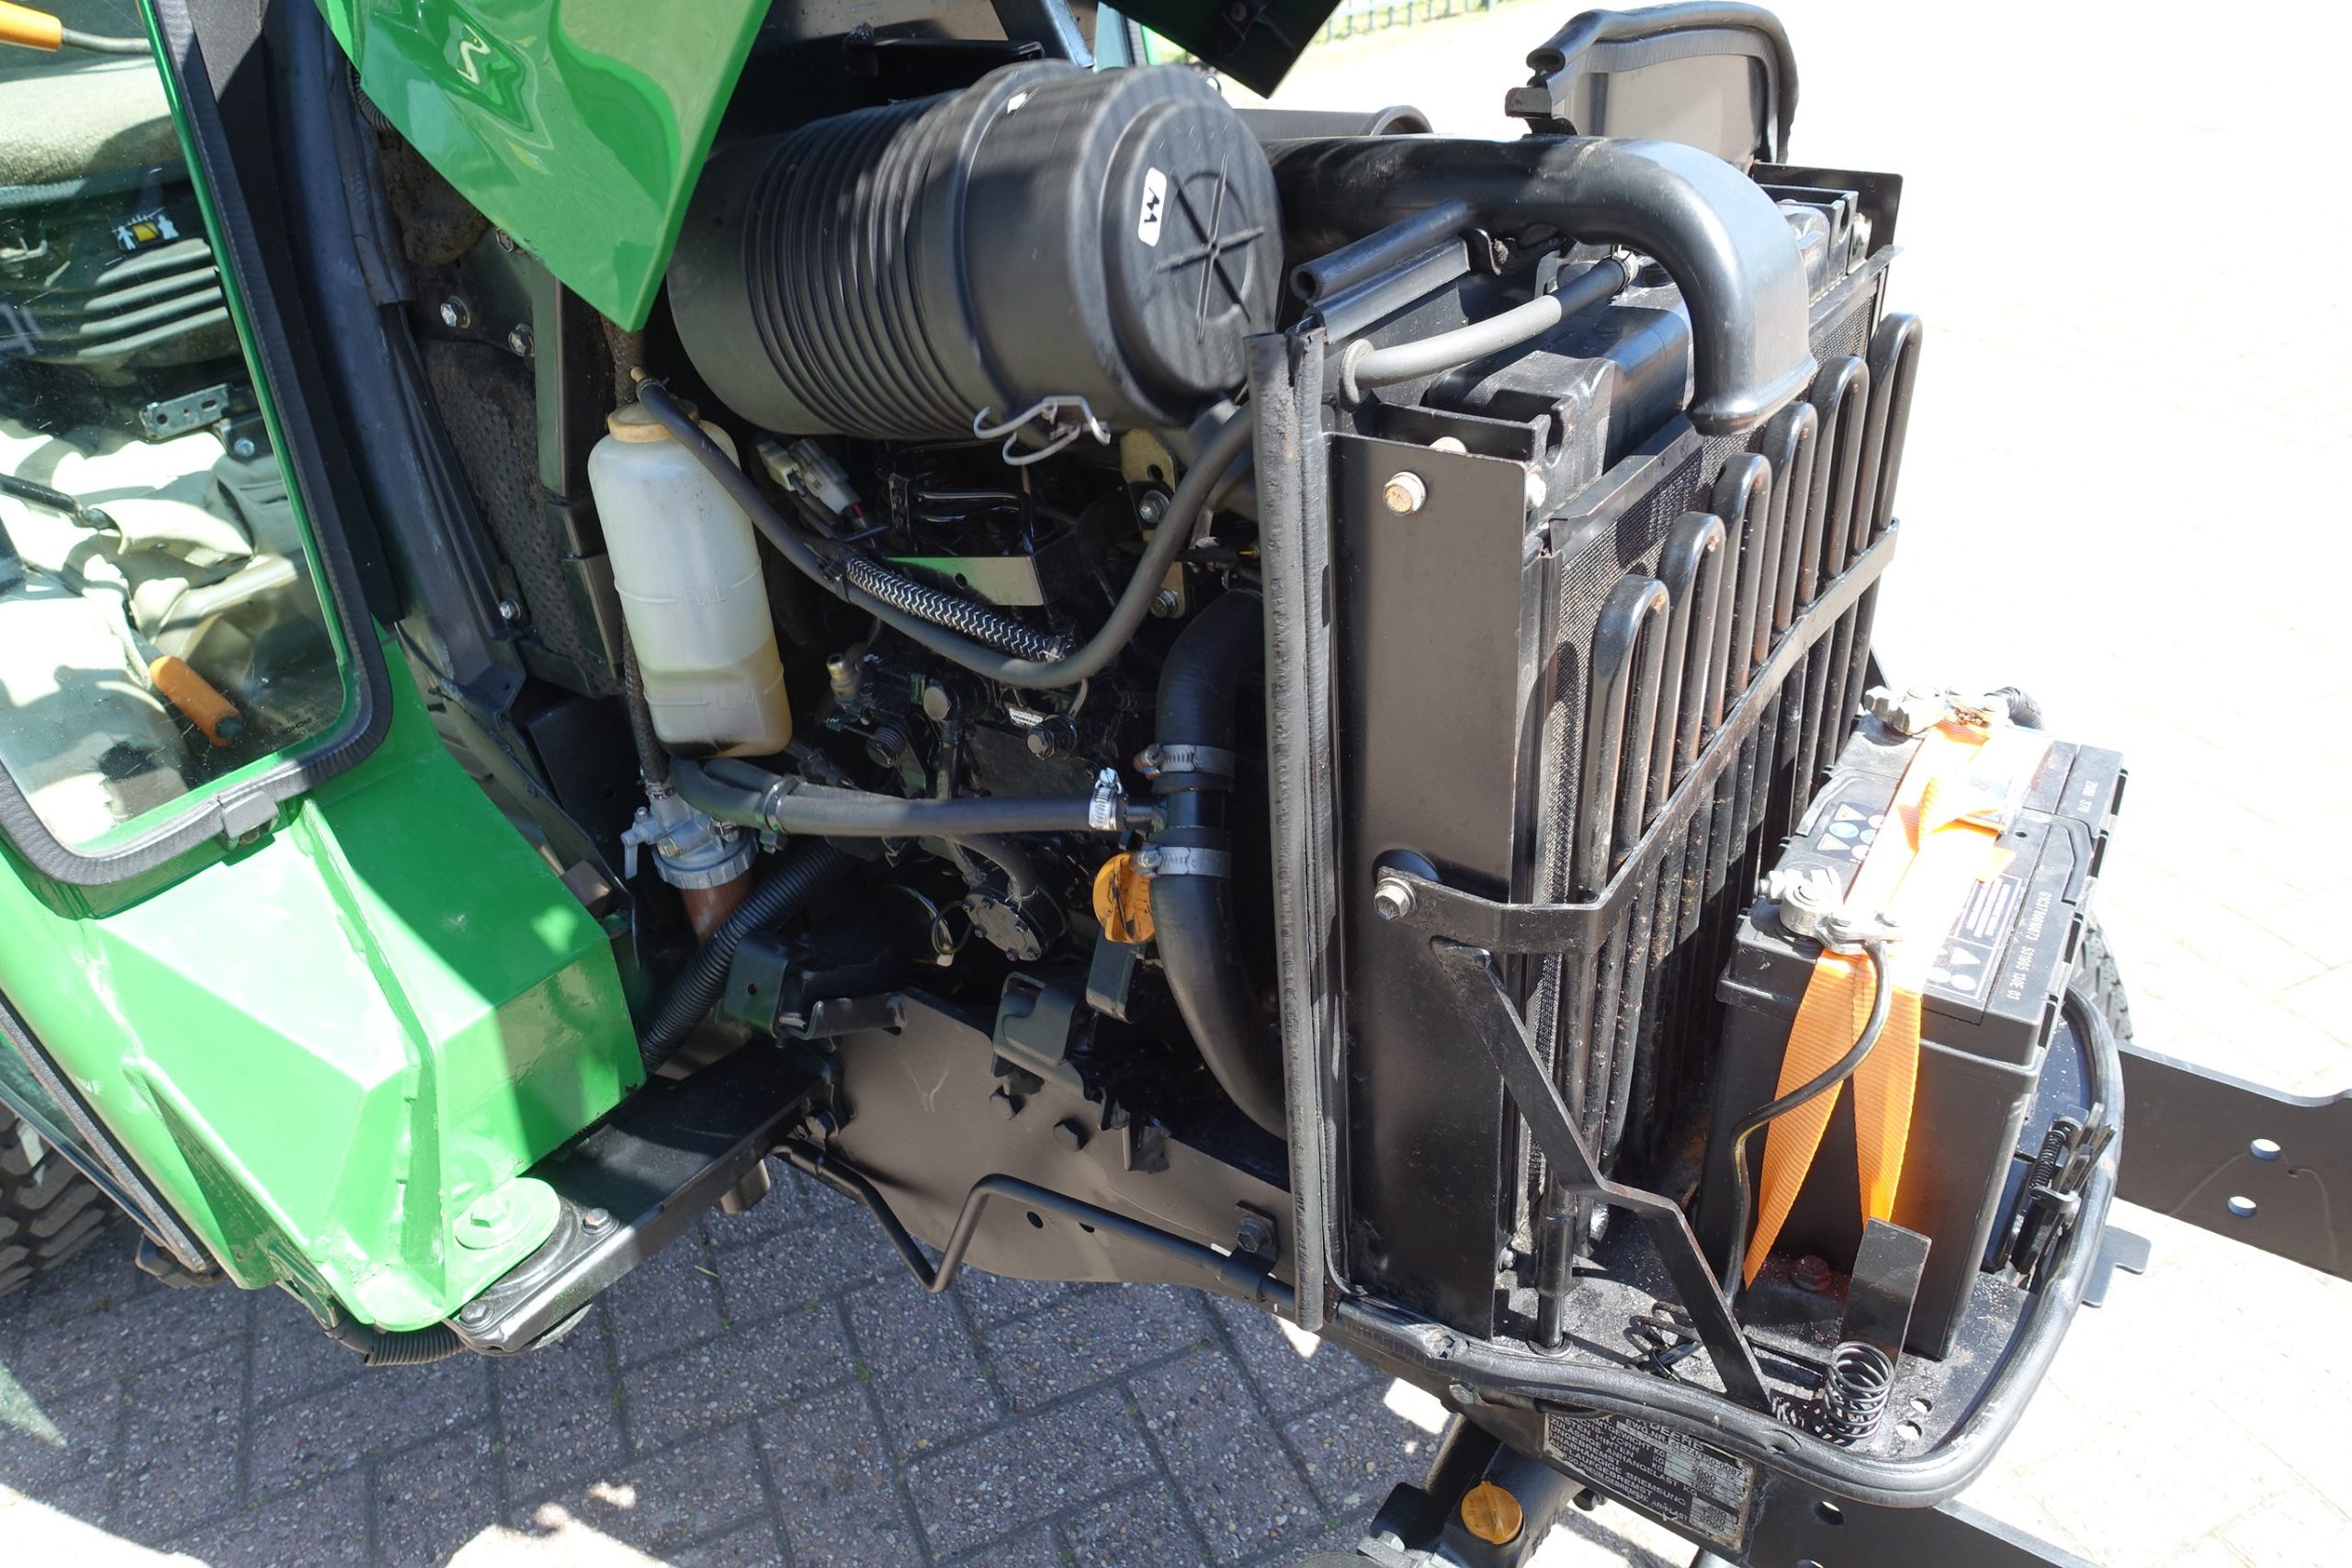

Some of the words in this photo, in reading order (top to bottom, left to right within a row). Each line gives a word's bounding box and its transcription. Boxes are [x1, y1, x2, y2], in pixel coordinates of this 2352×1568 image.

[684, 584, 728, 606] FULL
[716, 688, 758, 710] LOW
[1550, 1424, 1622, 1466] UNGEBREMST
[1610, 1432, 1640, 1454] VORN
[1653, 1455, 1665, 1466] KG
[1654, 1447, 1666, 1458] KG
[1652, 1461, 1664, 1472] KG
[1682, 1484, 1698, 1497] KG
